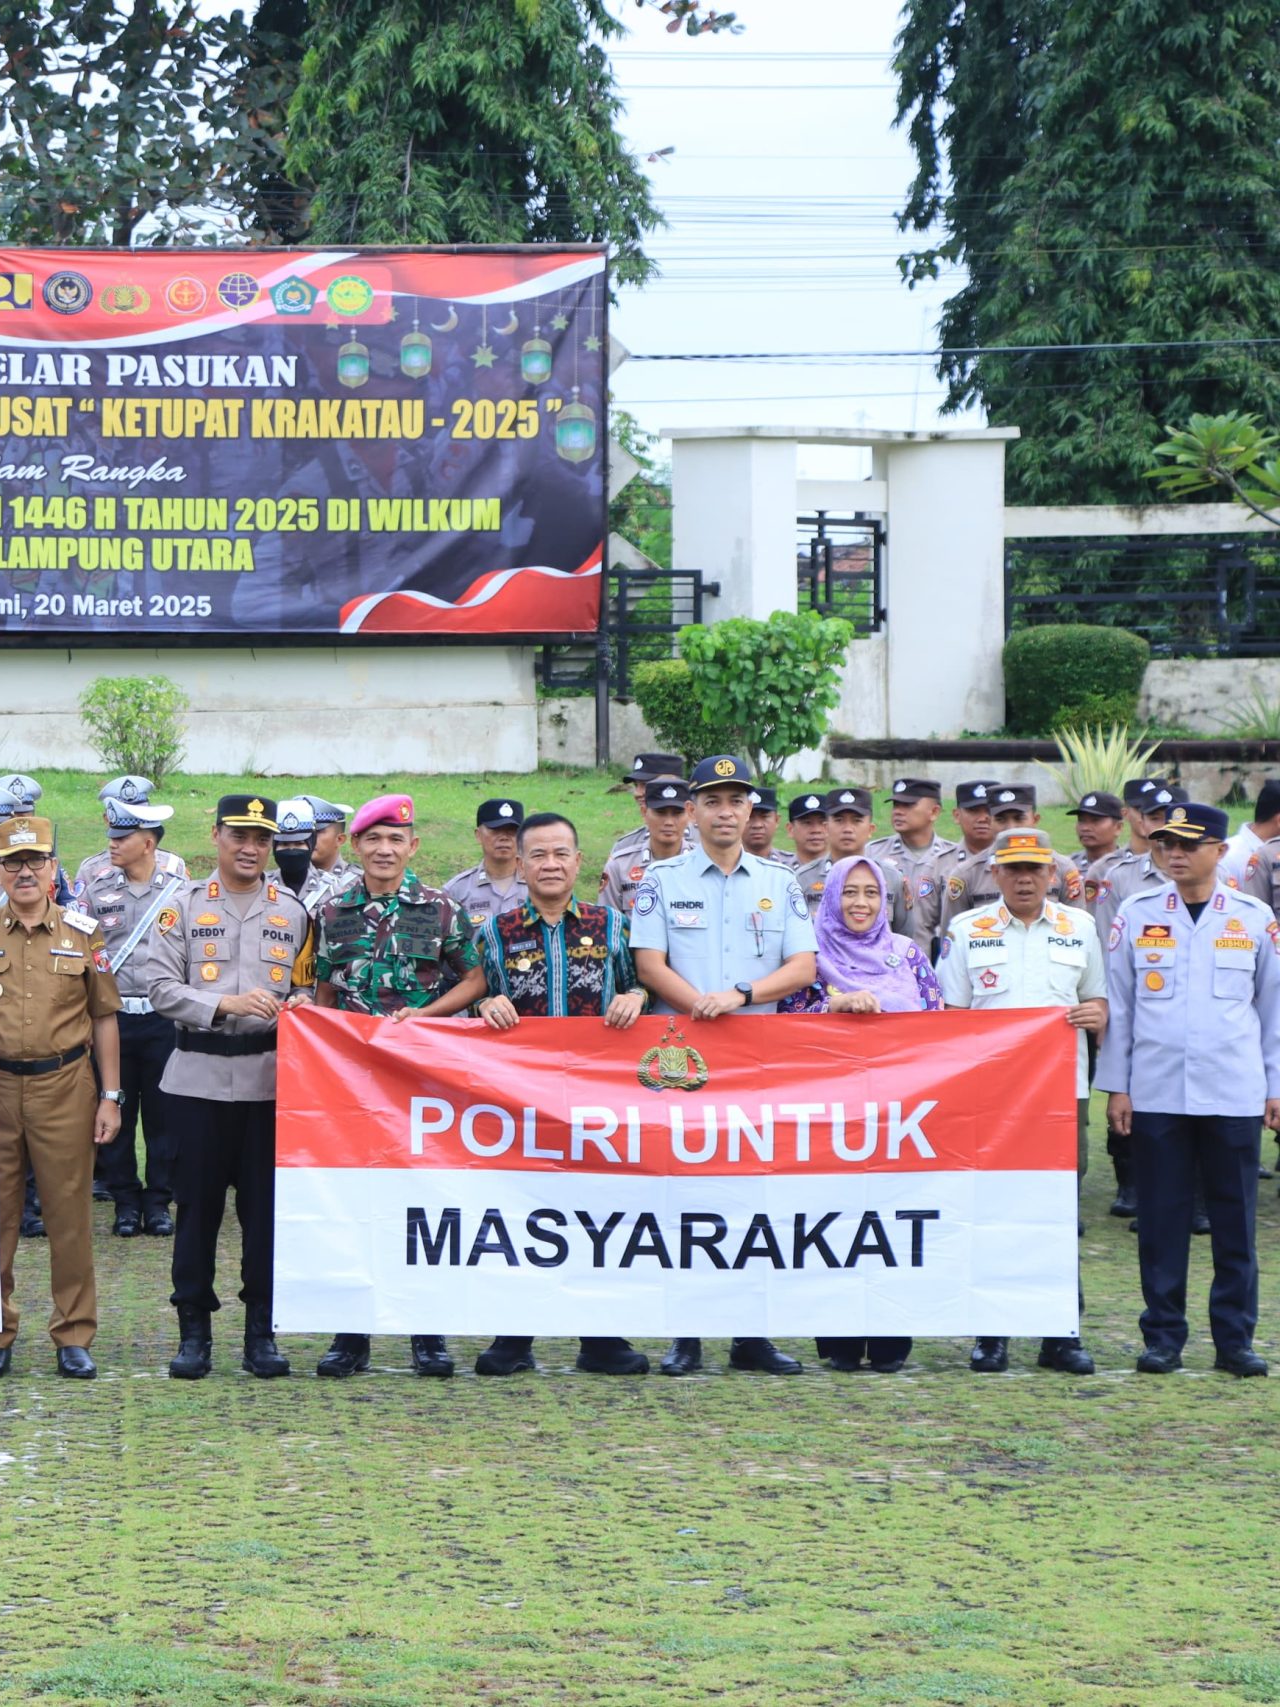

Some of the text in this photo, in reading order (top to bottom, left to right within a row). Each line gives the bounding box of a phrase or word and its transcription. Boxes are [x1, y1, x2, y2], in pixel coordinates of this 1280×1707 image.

[106, 354, 298, 388] PASUKAN
[252, 399, 424, 439] KRAKATAU
[60, 454, 187, 489] Rangka
[10, 496, 87, 530] 1446
[94, 497, 116, 531] H
[124, 497, 228, 531] TAHUN
[235, 498, 319, 531] 2025
[327, 498, 361, 531] DI
[366, 497, 501, 532] WILKUM
[152, 538, 254, 571] UTARA
[34, 593, 66, 616] 20
[72, 594, 143, 617] Maret
[149, 594, 212, 617] 2025
[669, 901, 704, 910] HENDRI
[191, 928, 226, 939] DEDDY
[262, 929, 294, 943] POLRI
[969, 938, 1006, 950] KHAIRUL
[1217, 940, 1252, 949] DISHUB
[409, 1095, 939, 1165] POLRI UNTUK
[405, 1207, 940, 1270] MASYARAKAT
